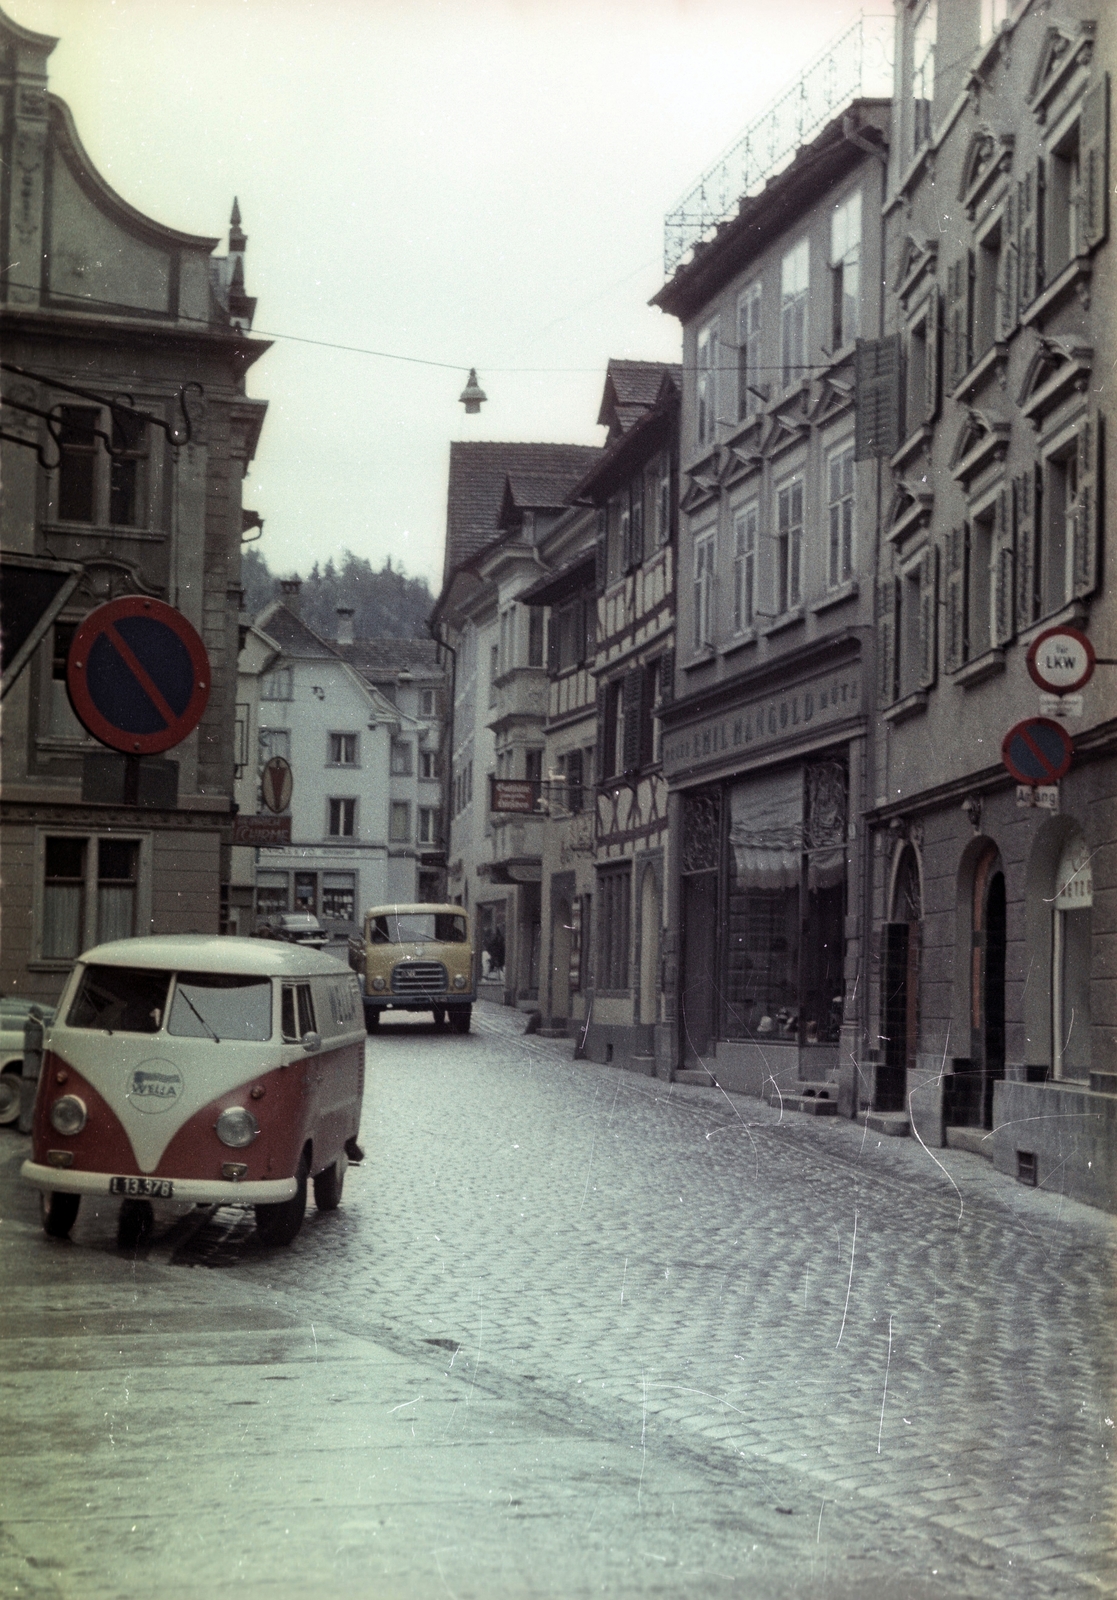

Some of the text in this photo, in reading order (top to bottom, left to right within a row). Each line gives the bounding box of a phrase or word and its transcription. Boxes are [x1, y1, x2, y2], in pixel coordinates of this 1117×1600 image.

[1046, 656, 1076, 669] LKW
[693, 723, 728, 758] EMIL
[732, 691, 814, 747] MARGOLD
[1017, 788, 1056, 806] Anang
[132, 1083, 177, 1097] WELLA
